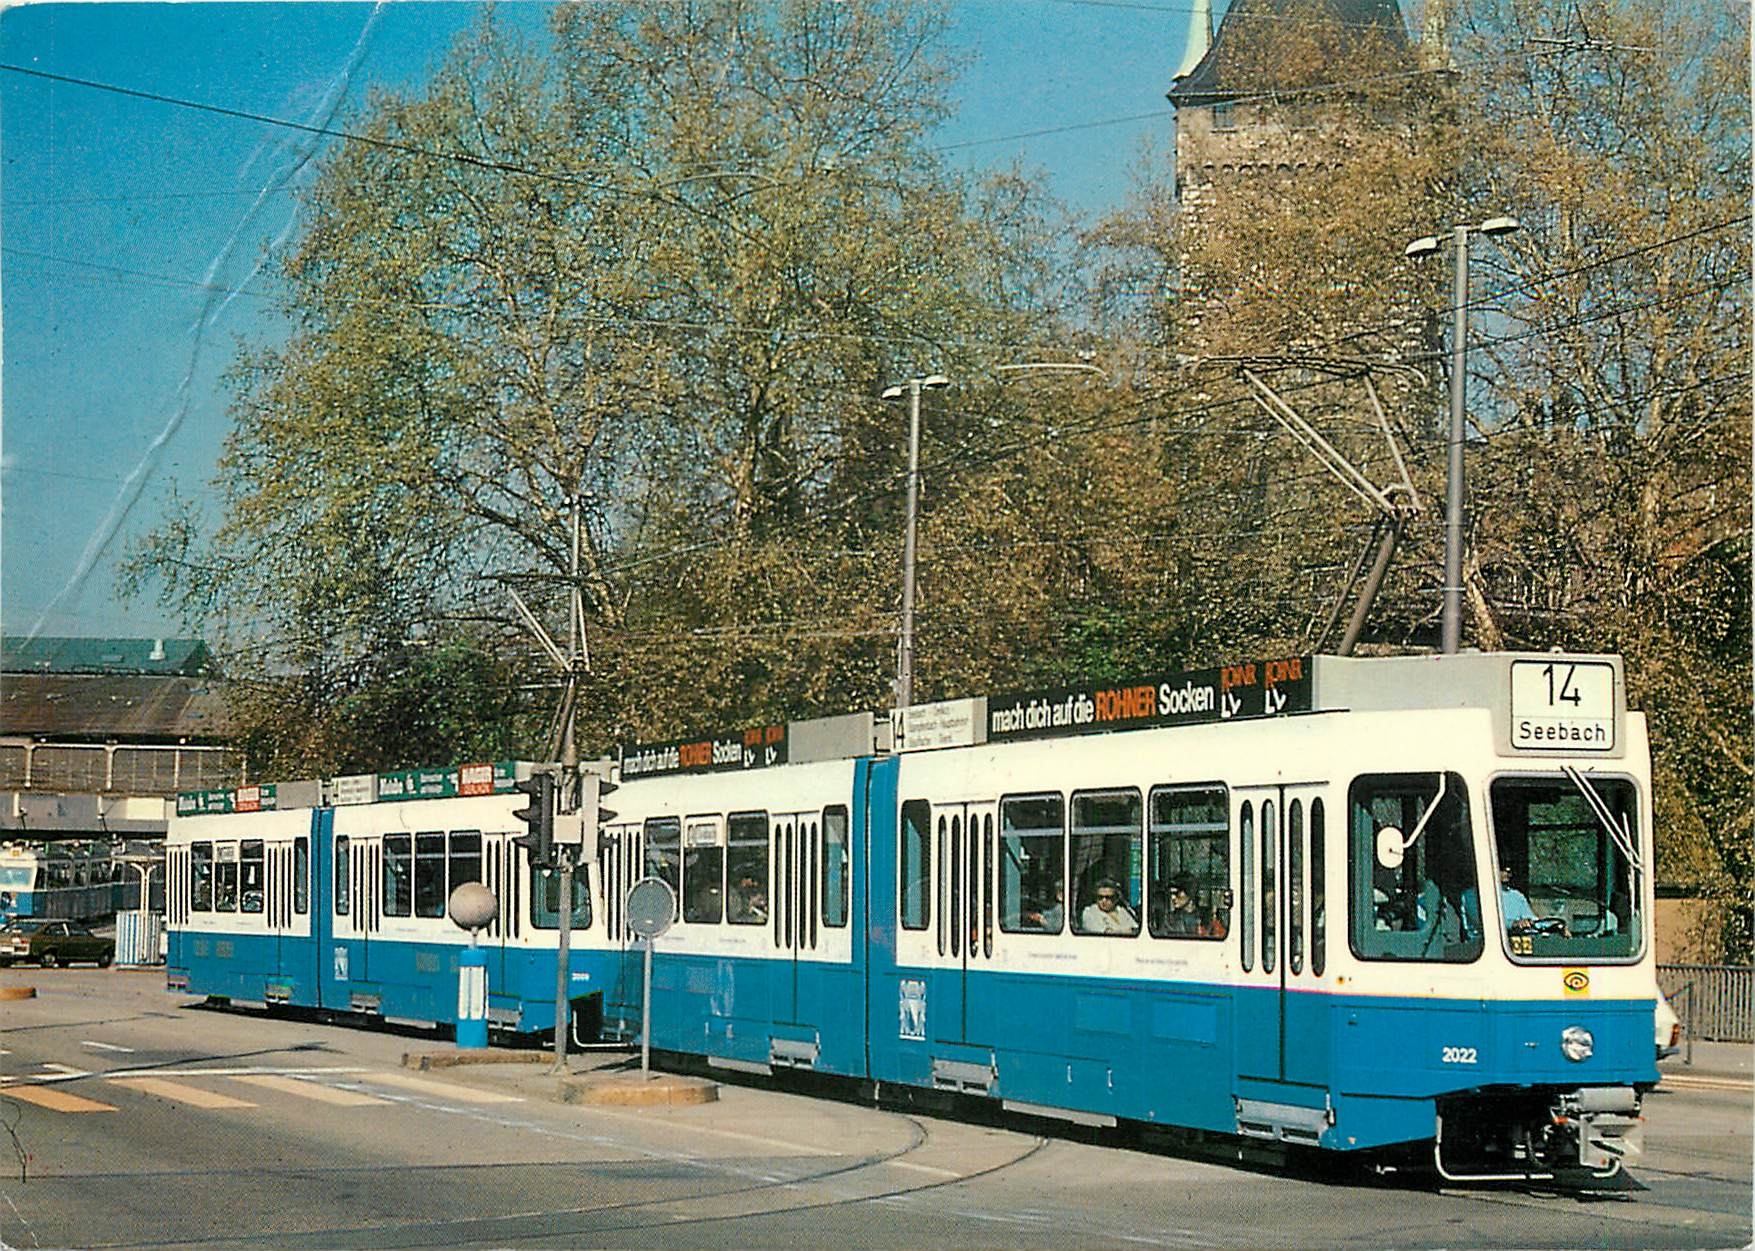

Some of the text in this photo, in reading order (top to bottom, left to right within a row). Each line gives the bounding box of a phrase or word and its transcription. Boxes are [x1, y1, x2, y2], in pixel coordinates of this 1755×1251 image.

[1543, 664, 1581, 707] 14
[992, 701, 1024, 732] mach
[1026, 699, 1051, 729] dich
[1053, 695, 1074, 726] auf
[1074, 693, 1094, 724] die
[1095, 686, 1156, 721] ROHNER
[1159, 681, 1214, 715] Socken
[892, 711, 905, 749] 14
[1520, 721, 1605, 741] Seebach
[1442, 1047, 1478, 1063] 2022
